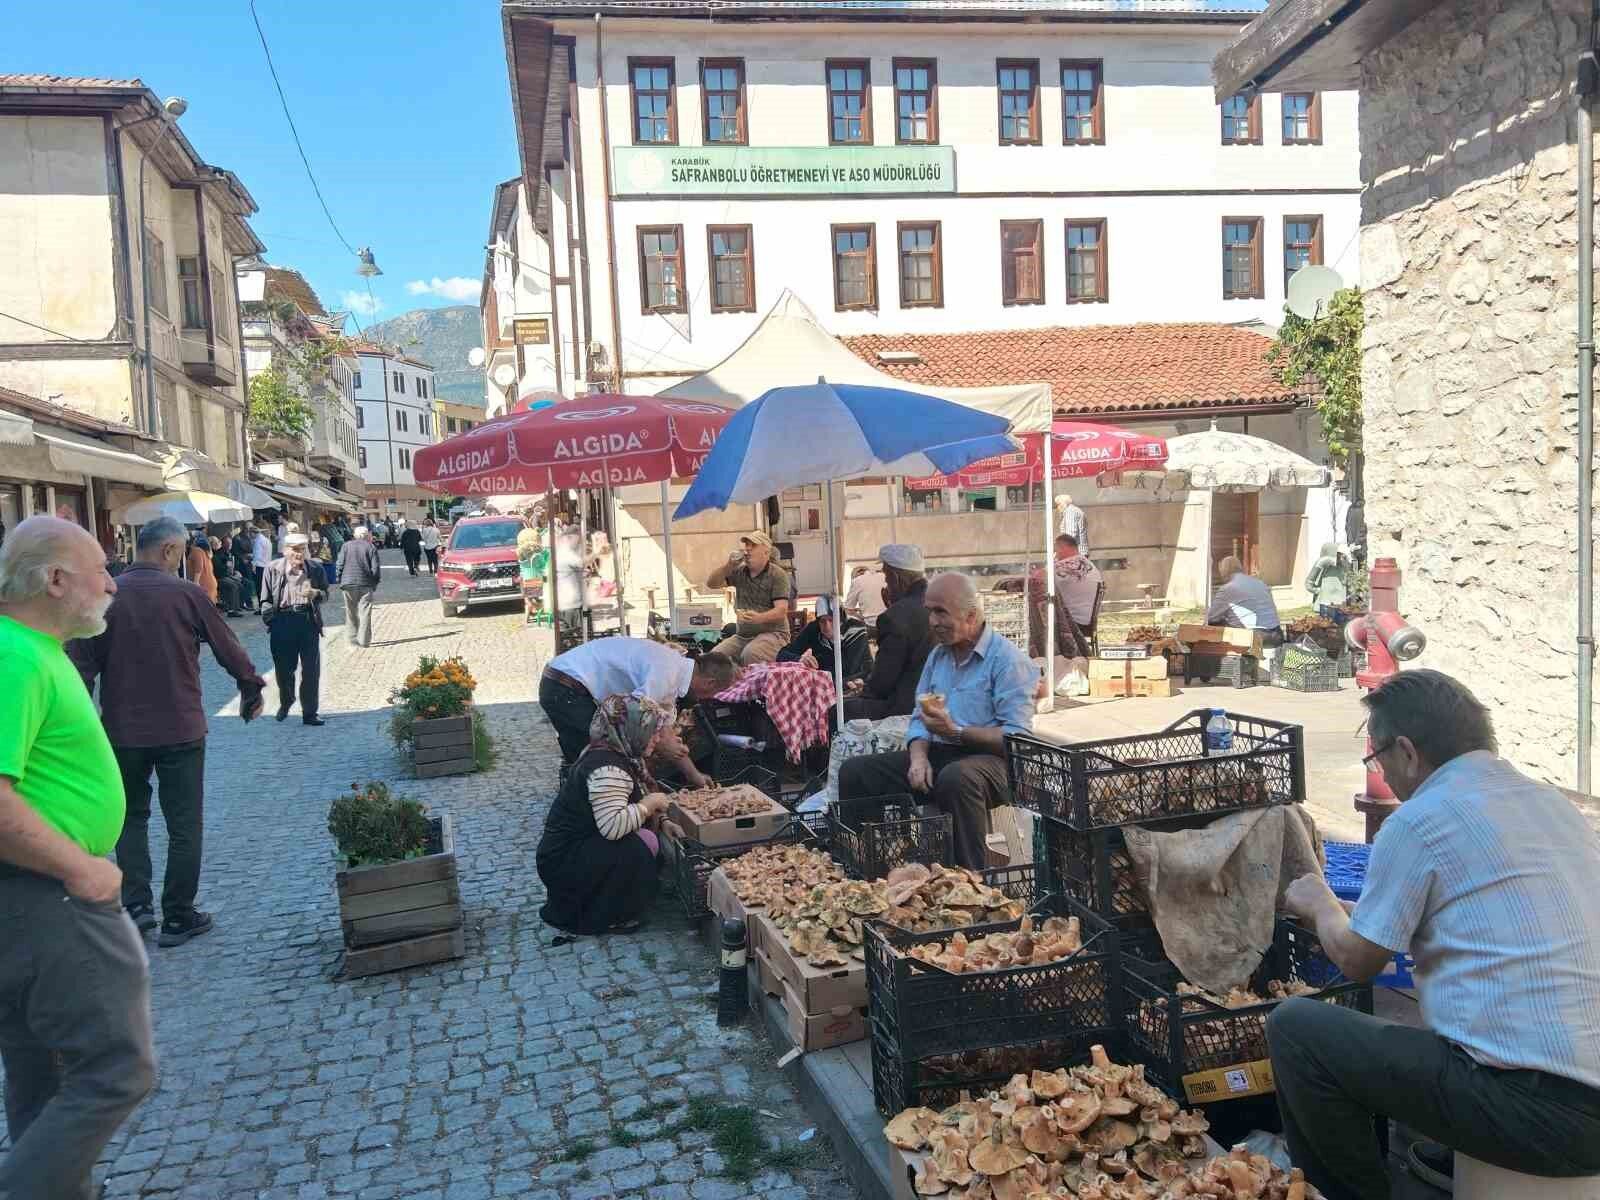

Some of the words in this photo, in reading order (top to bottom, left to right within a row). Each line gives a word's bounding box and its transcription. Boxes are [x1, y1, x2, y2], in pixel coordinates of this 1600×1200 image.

[671, 157, 711, 166] KARABÜK
[671, 168, 748, 183] SAFRANBOLU
[750, 164, 830, 183] ÖĞRETMENEVİ
[832, 168, 847, 182] VE
[848, 167, 871, 182] ASO
[873, 163, 942, 181] MÜDÜRLÜĞÜ
